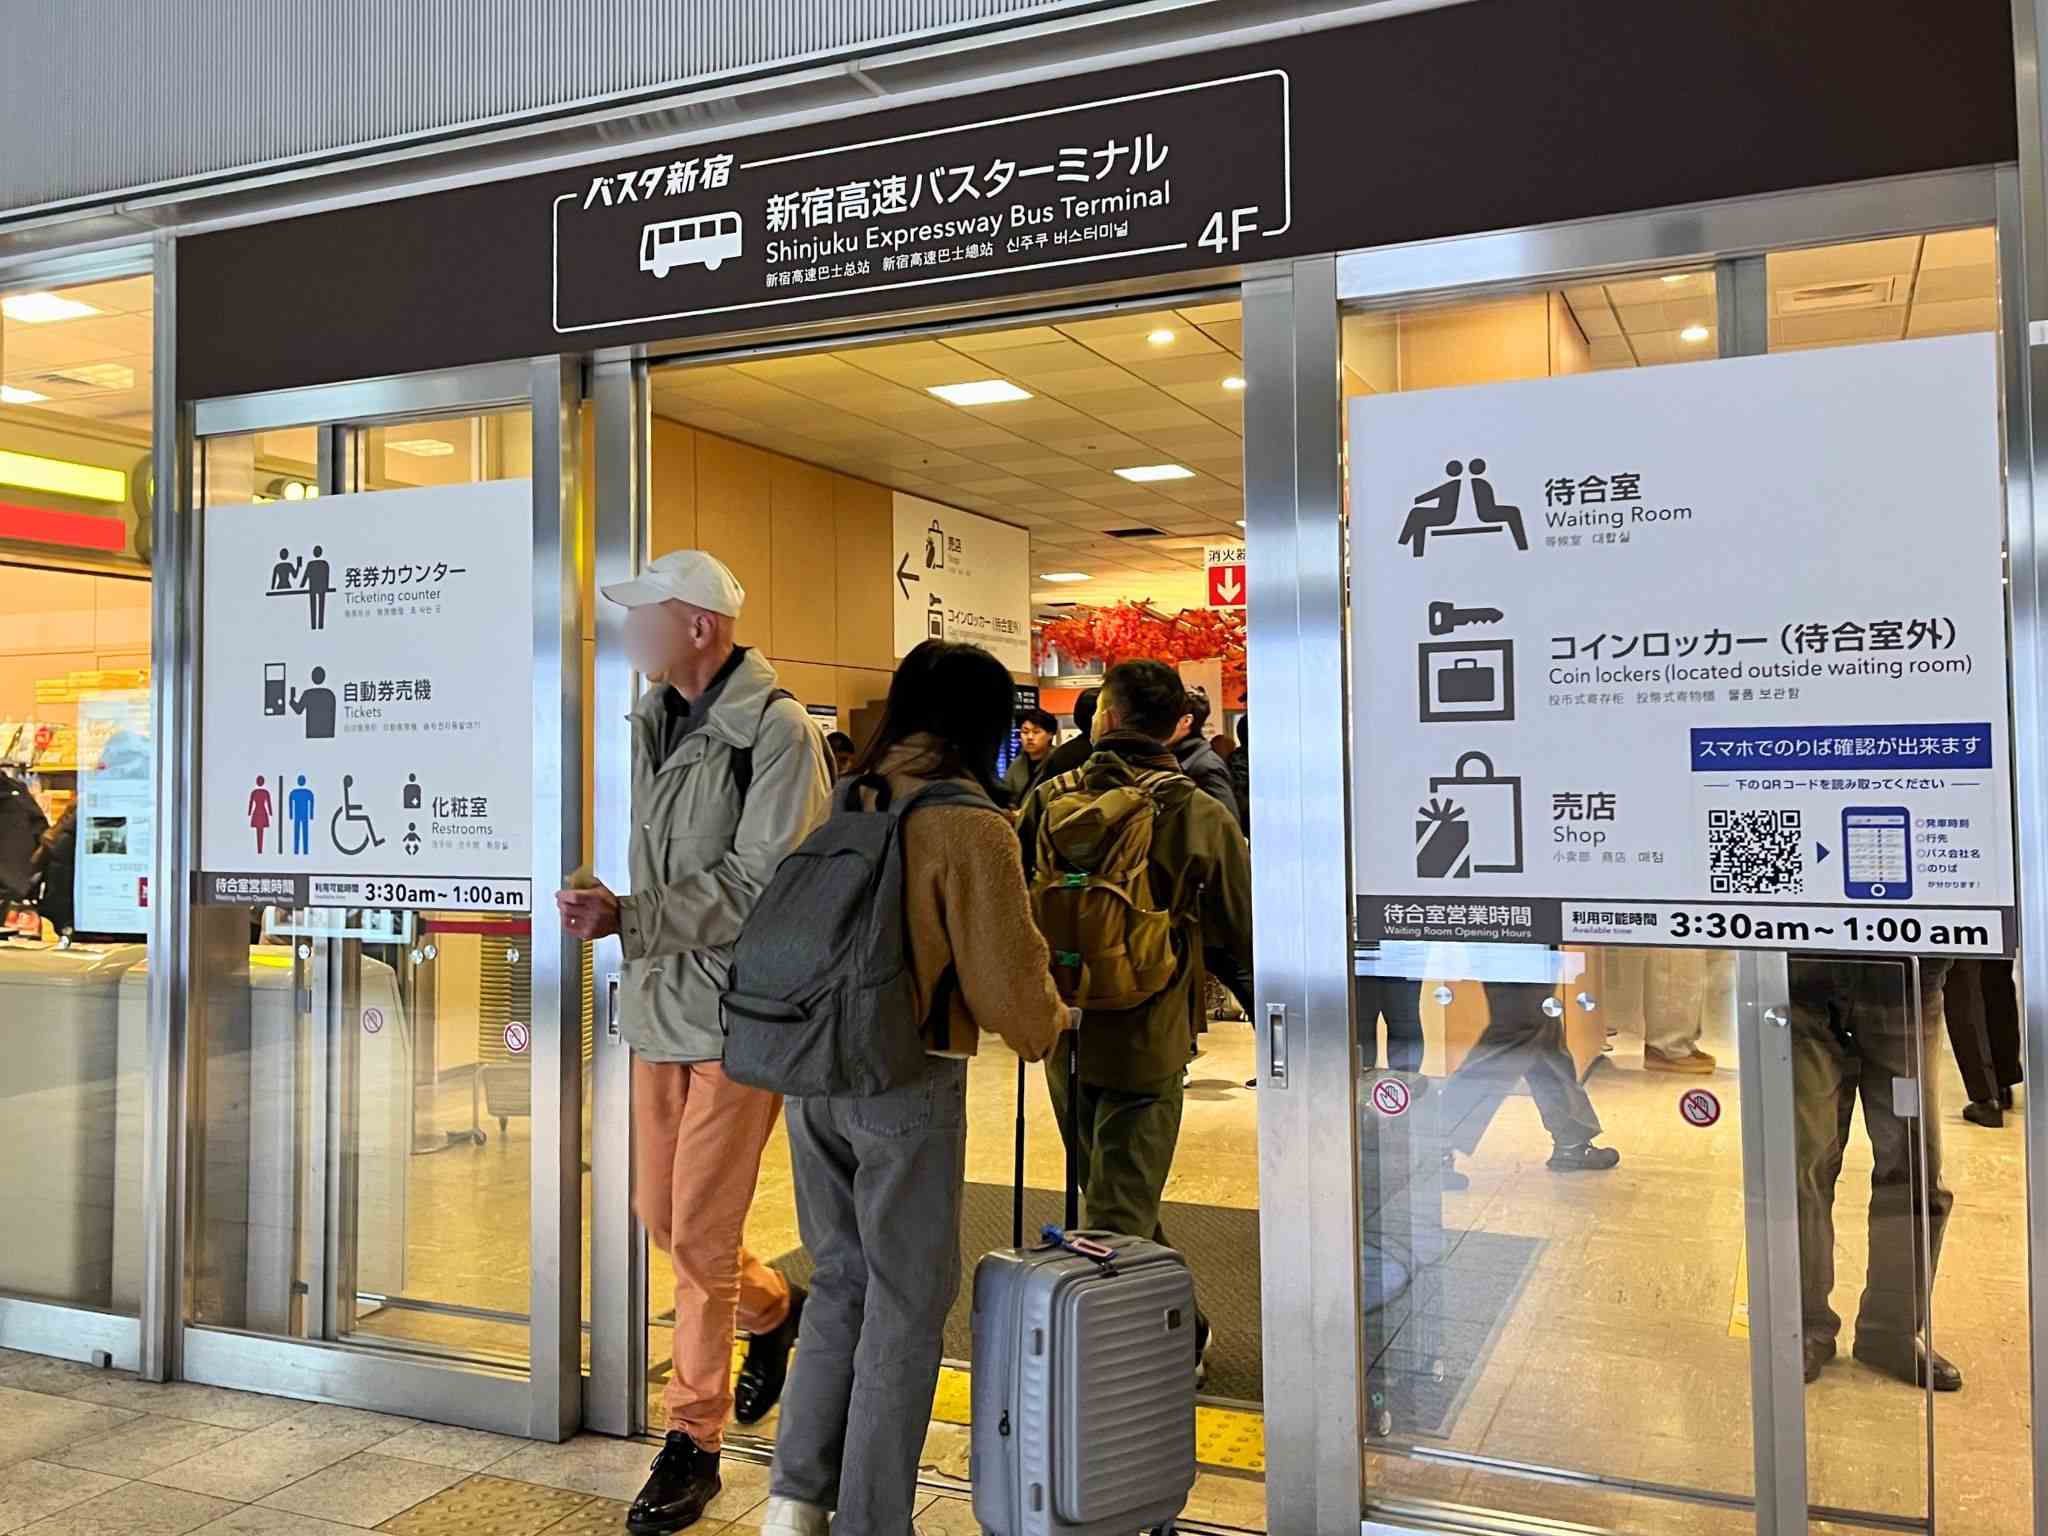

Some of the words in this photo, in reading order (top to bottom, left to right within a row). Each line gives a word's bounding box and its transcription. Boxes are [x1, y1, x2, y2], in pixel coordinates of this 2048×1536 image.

[584, 154, 733, 210] バスタ新宿
[766, 133, 1169, 233] 新宿高速バスターミナル
[766, 229, 858, 263] Shinjuku
[866, 213, 1003, 252] Expressway
[1011, 204, 1054, 227] Bus
[1061, 179, 1170, 220] Terminal
[1198, 206, 1259, 254] 4F
[1006, 234, 1049, 253] 신주쿠
[1054, 220, 1128, 246] 버스터미널
[1545, 472, 1641, 507] 待合室
[1545, 509, 1624, 528] Waiting
[1631, 506, 1692, 523] Room
[345, 562, 466, 588] 発券カウンター
[345, 591, 395, 605] Ticketing
[398, 589, 441, 601] counter
[1549, 667, 1590, 684] Coin
[1596, 665, 1661, 683] lockers
[1665, 661, 1743, 683] (located
[1748, 659, 1822, 678] outside
[1828, 657, 1903, 679] waiting
[1909, 654, 1972, 675] room)
[344, 679, 432, 702] 自動券売機
[344, 705, 382, 718] Tickets
[1700, 736, 1981, 757] スマホでのりば確認が出来ます
[1735, 778, 1945, 791] 下のQRコードを読み取ってください
[432, 796, 488, 818] 化粧室
[1552, 791, 1616, 821] 売店
[432, 822, 493, 835] Restrooms
[1553, 825, 1606, 848] Shop
[1384, 904, 1532, 927] 待合室営業時間
[1572, 911, 1657, 925] 利用可能時間
[1384, 926, 1421, 938] Waiting
[1424, 927, 1453, 937] Room
[1455, 928, 1499, 939] Opening
[1502, 929, 1532, 938] Hours
